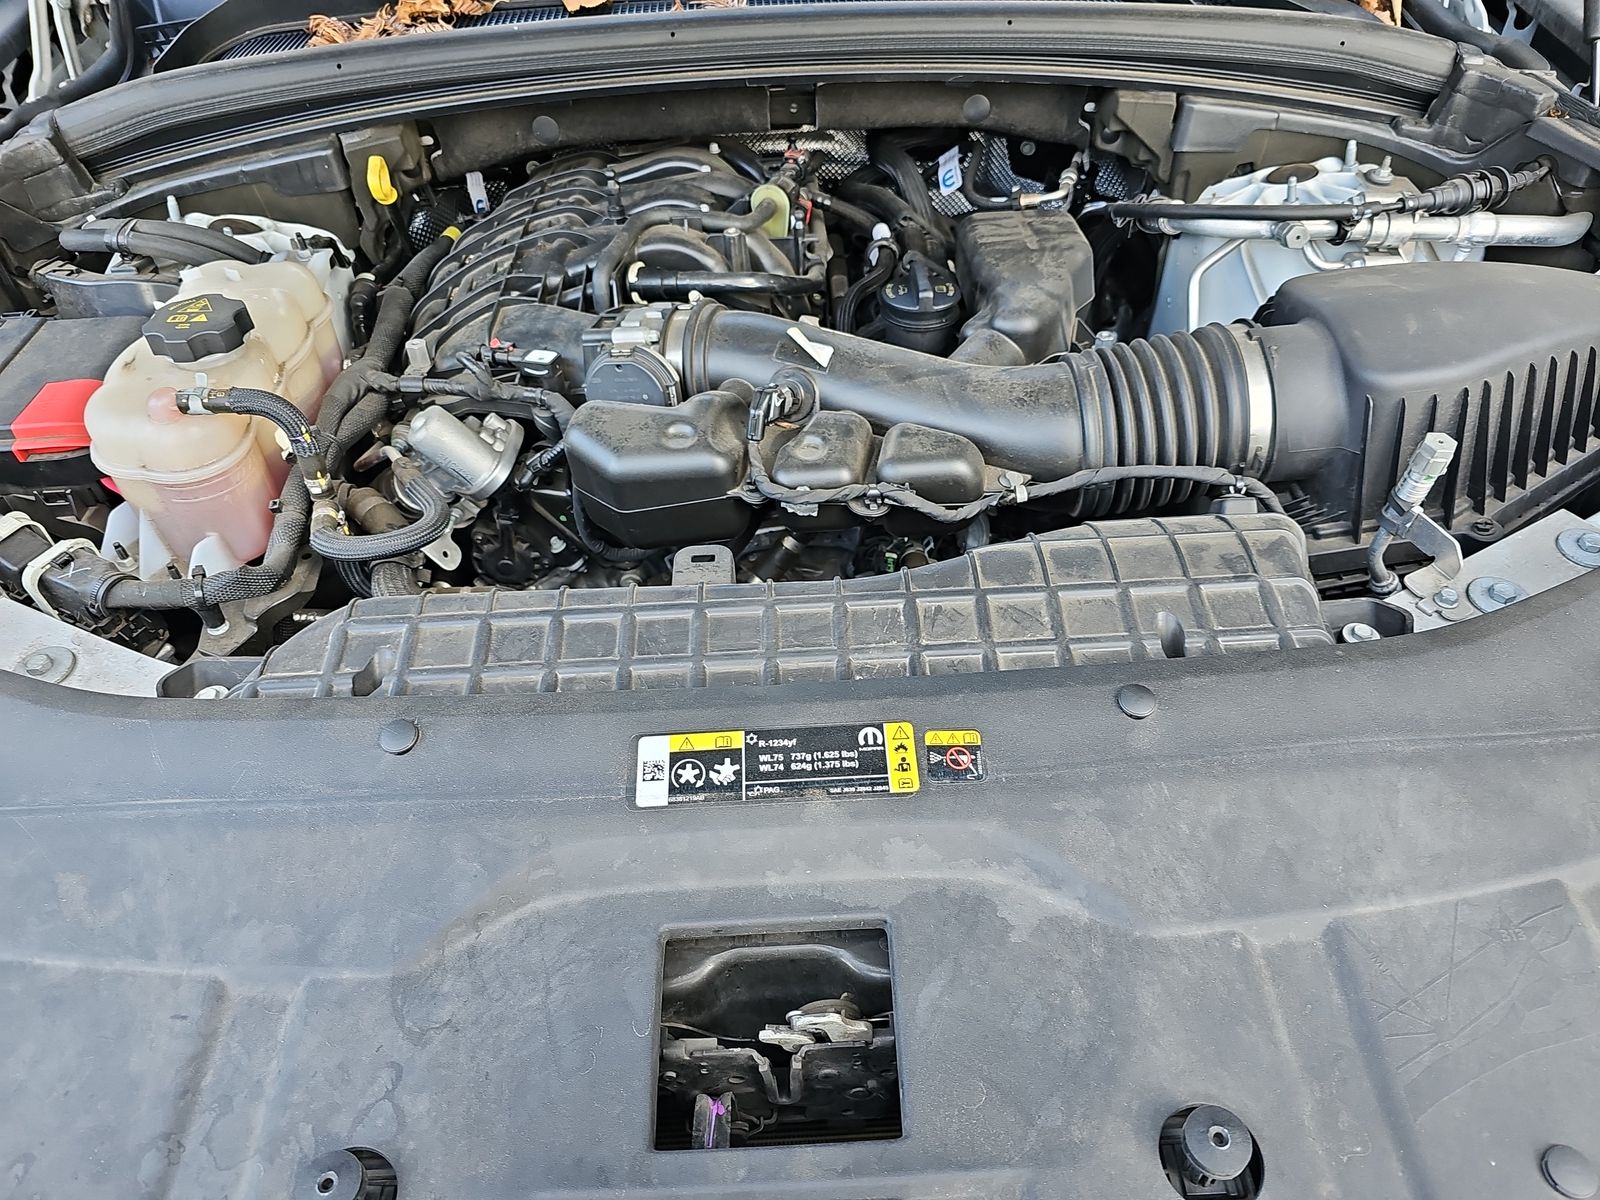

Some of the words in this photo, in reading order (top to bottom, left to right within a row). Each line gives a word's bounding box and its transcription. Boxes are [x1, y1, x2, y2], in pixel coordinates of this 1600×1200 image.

[759, 739, 797, 747] R-1234yf
[759, 754, 784, 762] WL75
[790, 753, 812, 761] 737g
[813, 751, 840, 760] (1.625
[841, 750, 858, 759] lbs)
[759, 764, 784, 772] WL74
[790, 762, 812, 771] 624g
[814, 761, 840, 770] (1.375
[842, 760, 859, 768] lbs)
[1500, 929, 1526, 941] 313
